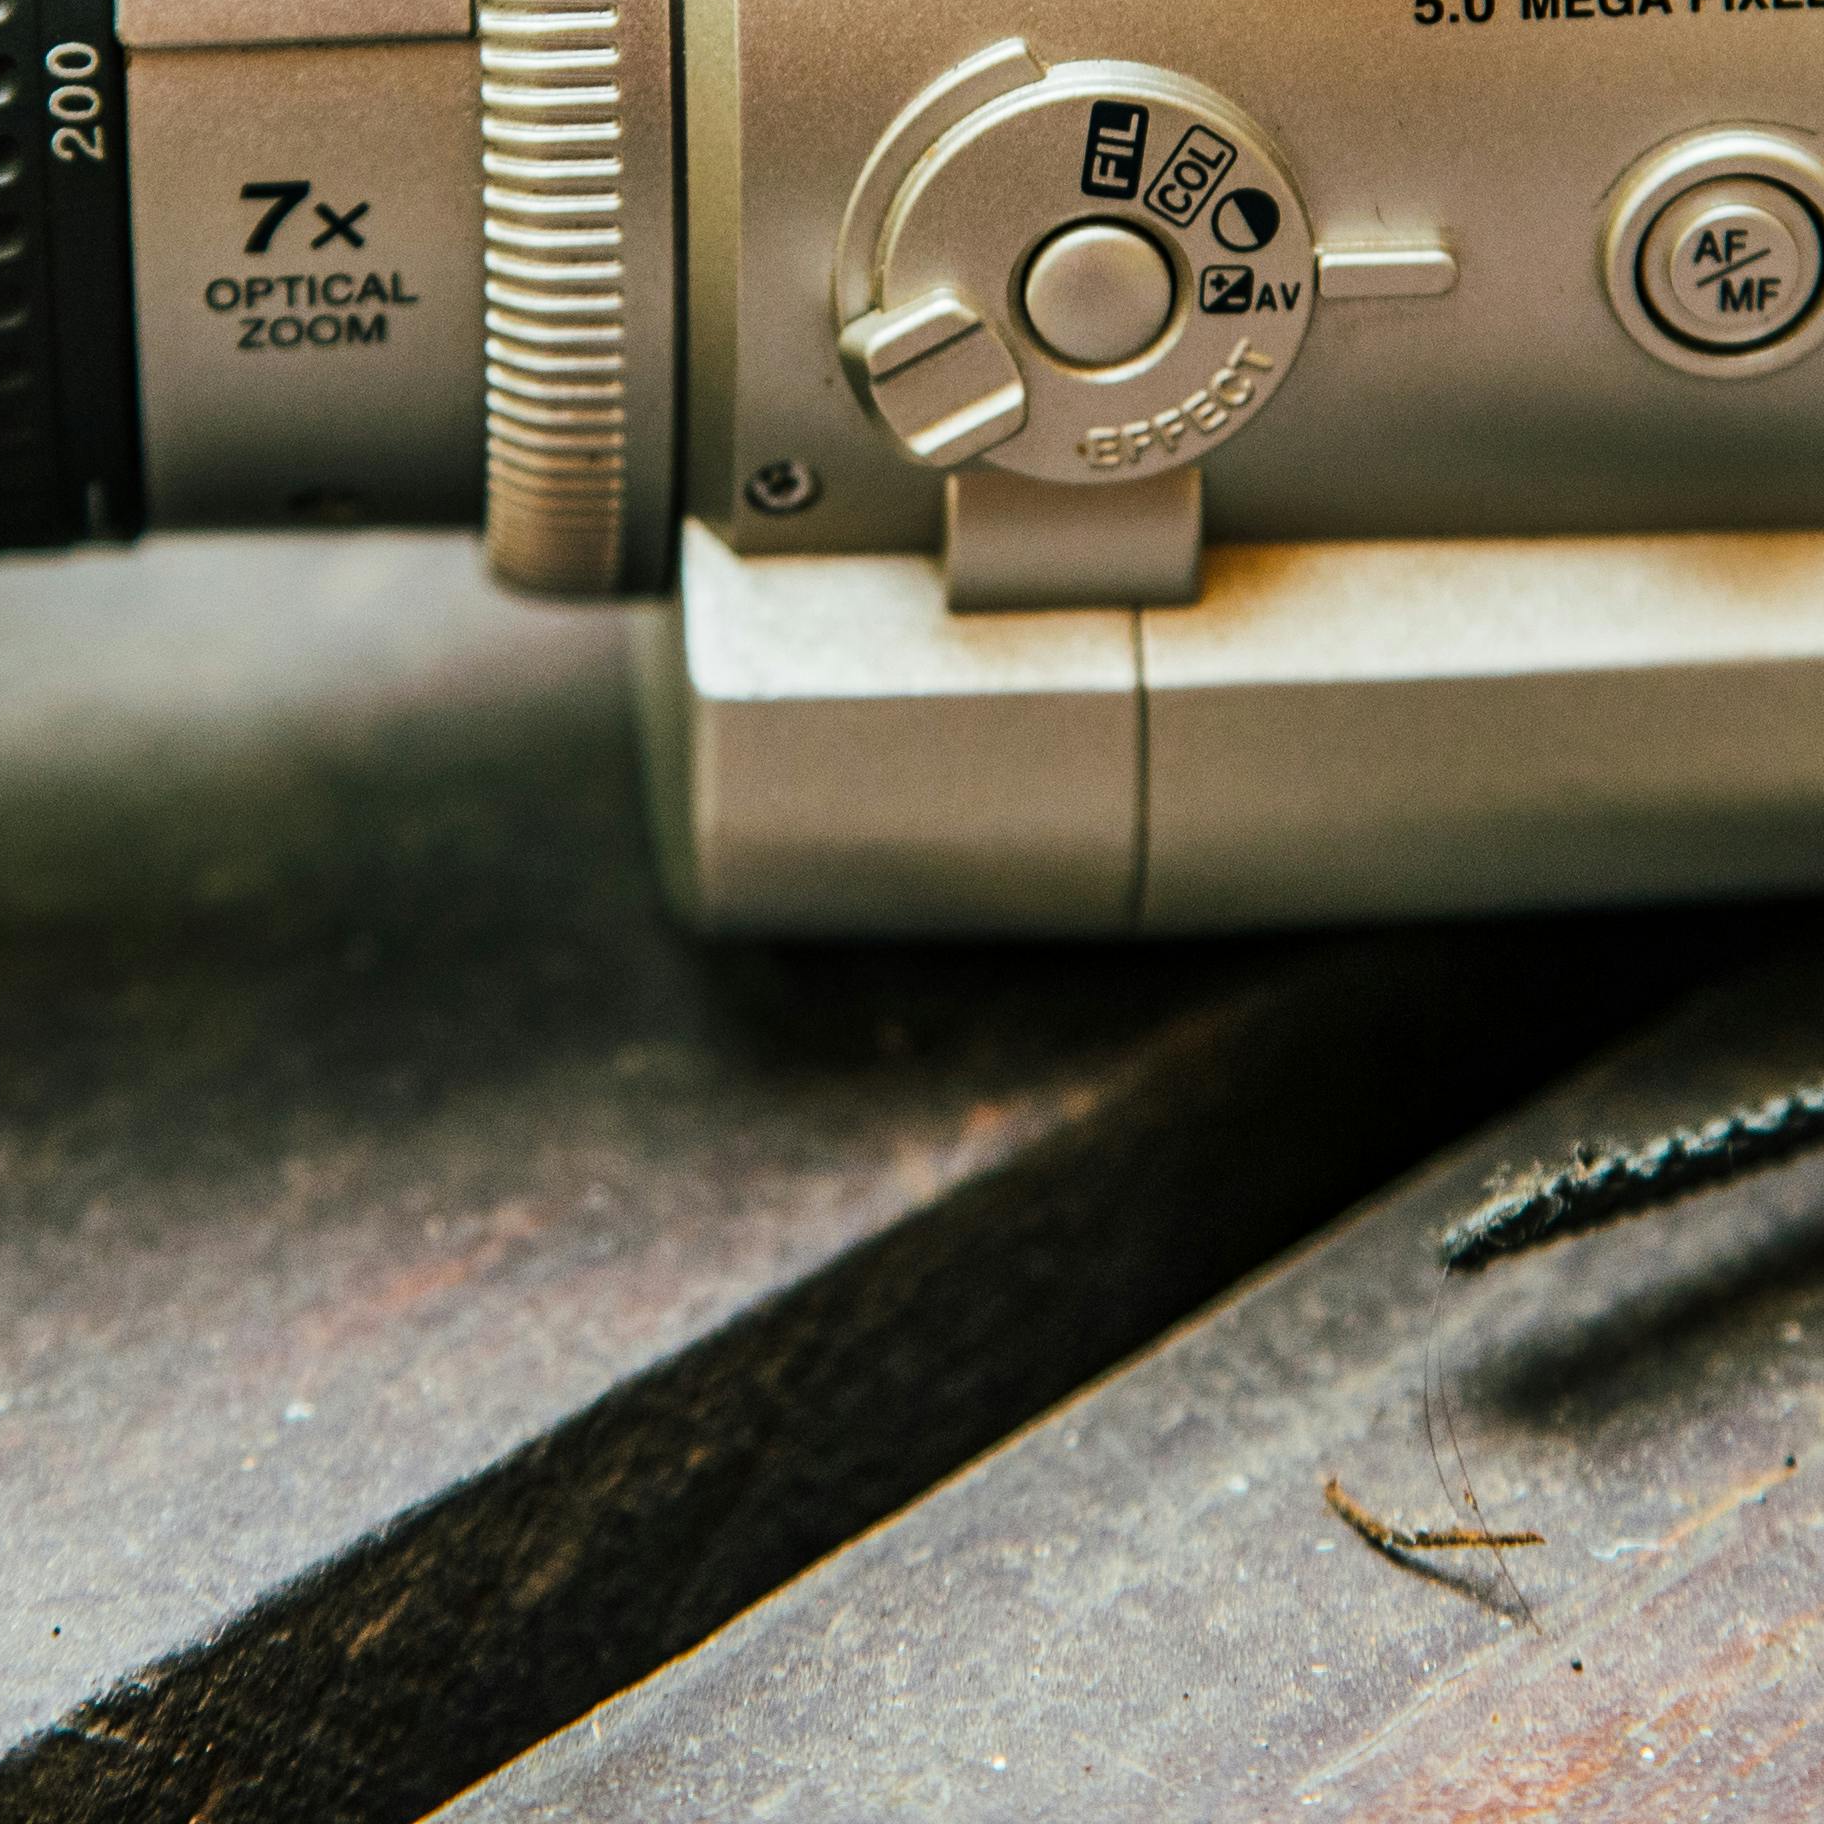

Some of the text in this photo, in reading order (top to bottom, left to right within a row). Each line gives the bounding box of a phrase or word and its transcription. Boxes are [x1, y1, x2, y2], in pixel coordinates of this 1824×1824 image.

[45, 41, 104, 162] 200
[1091, 112, 1140, 190] FIL
[1158, 145, 1226, 216] COL
[1692, 229, 1748, 264] AF
[205, 272, 419, 313] OPTICAL
[1256, 281, 1301, 312] AV
[1718, 277, 1781, 312] MF
[237, 314, 389, 350] ZOOM
[1086, 337, 1274, 468] EFFECT
